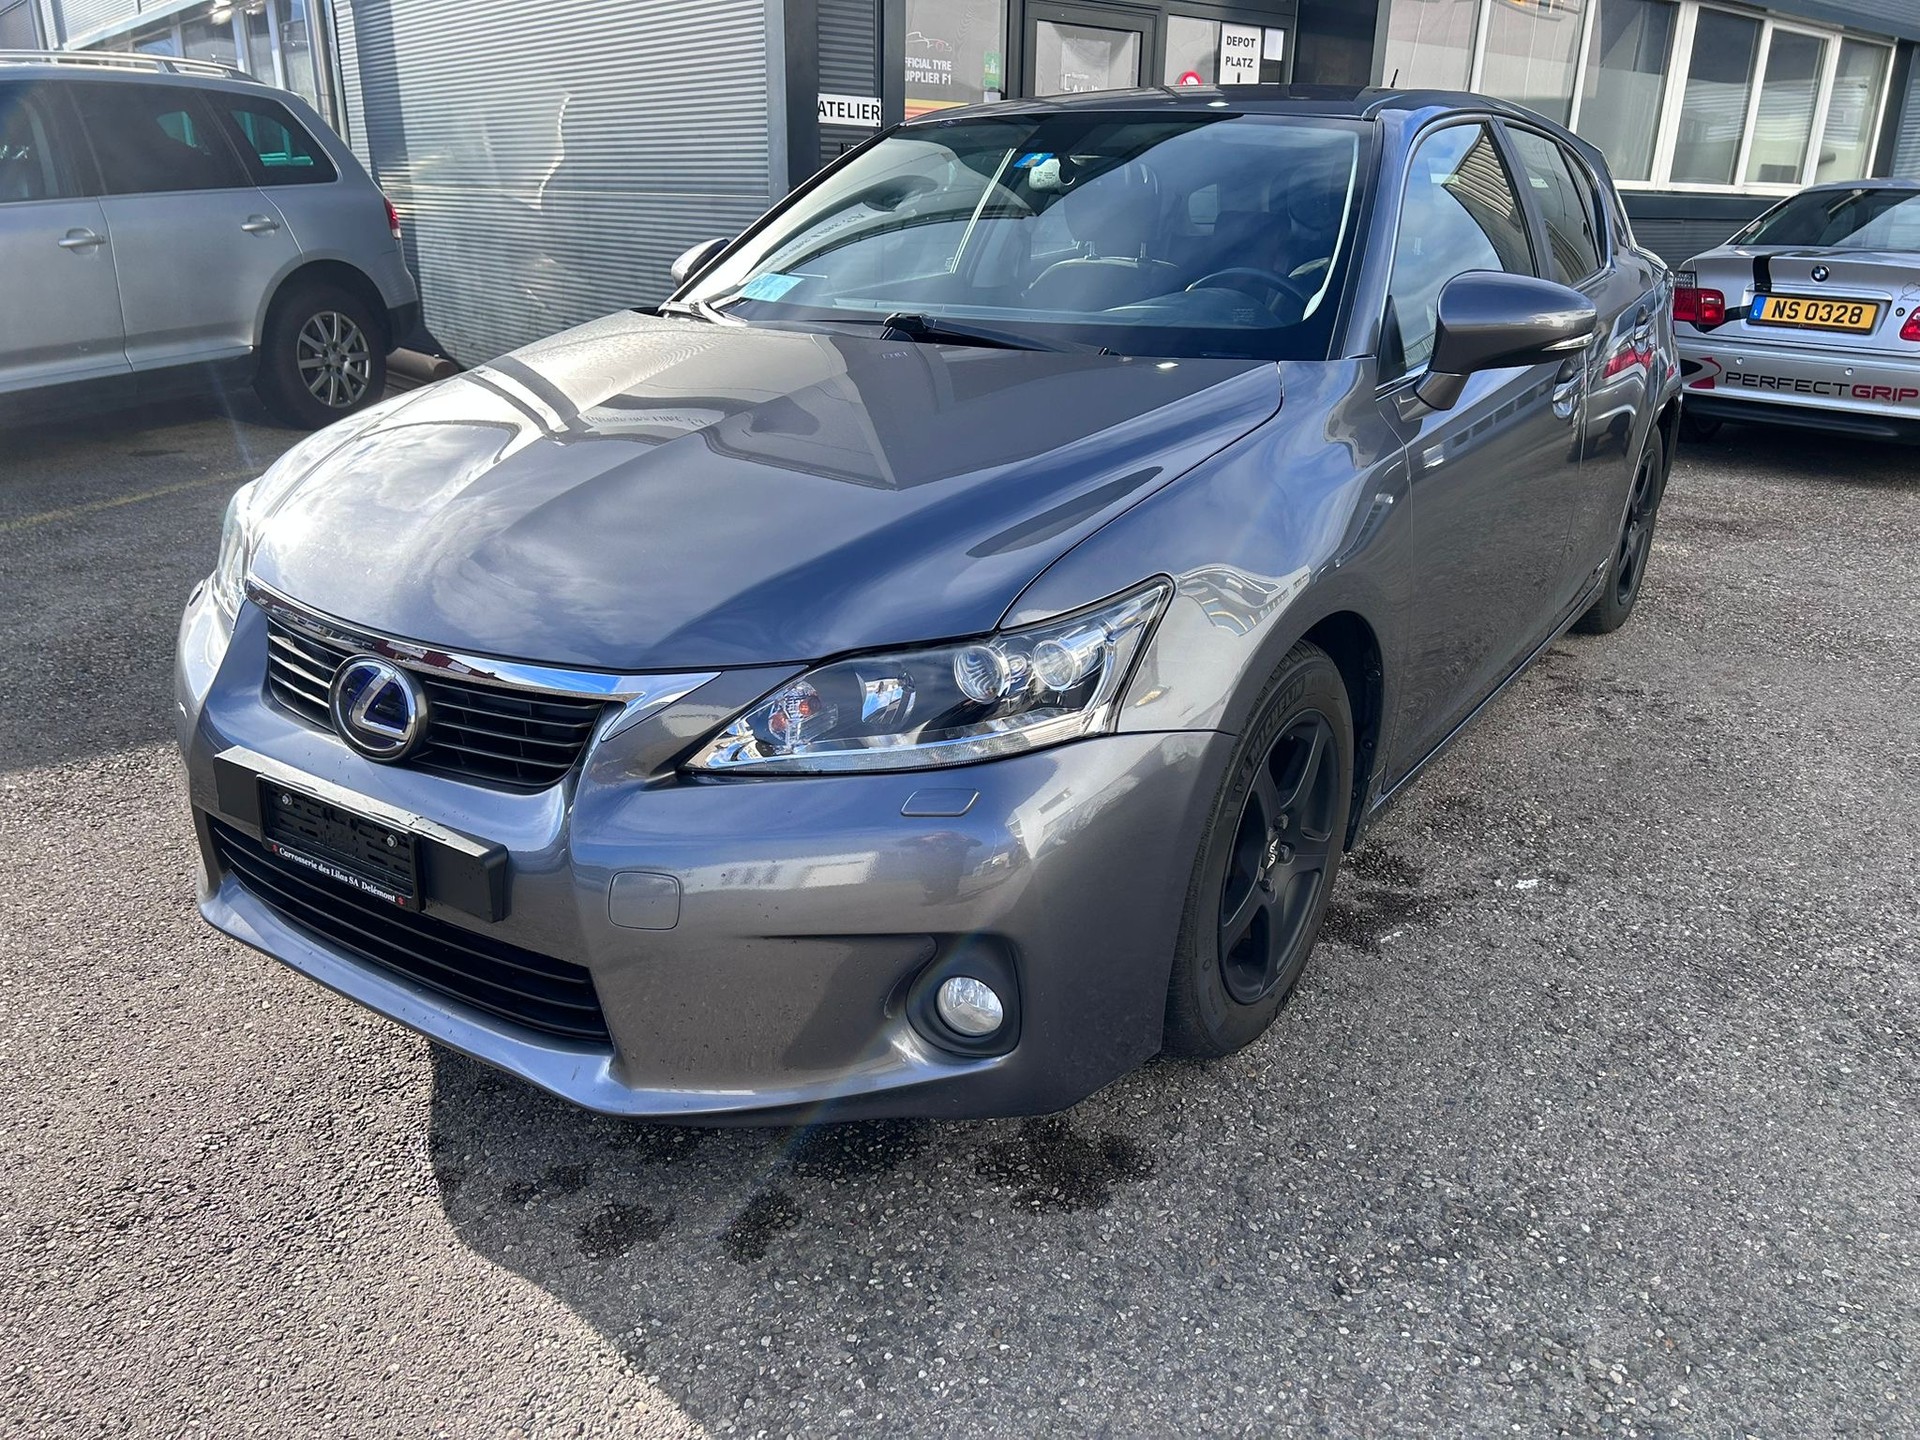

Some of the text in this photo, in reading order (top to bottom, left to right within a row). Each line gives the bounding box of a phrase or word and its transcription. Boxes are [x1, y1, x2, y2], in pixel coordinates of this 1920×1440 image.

[1226, 35, 1256, 48] DEPOT
[905, 57, 952, 71] FICIAL TYRE
[1225, 56, 1254, 68] PLATZ
[905, 70, 952, 85] UPPLIER F1
[817, 100, 880, 121] ATELIER
[1771, 300, 1863, 324] NS 0328
[279, 847, 396, 902] Carrosserie des Lilas SA Delémont
